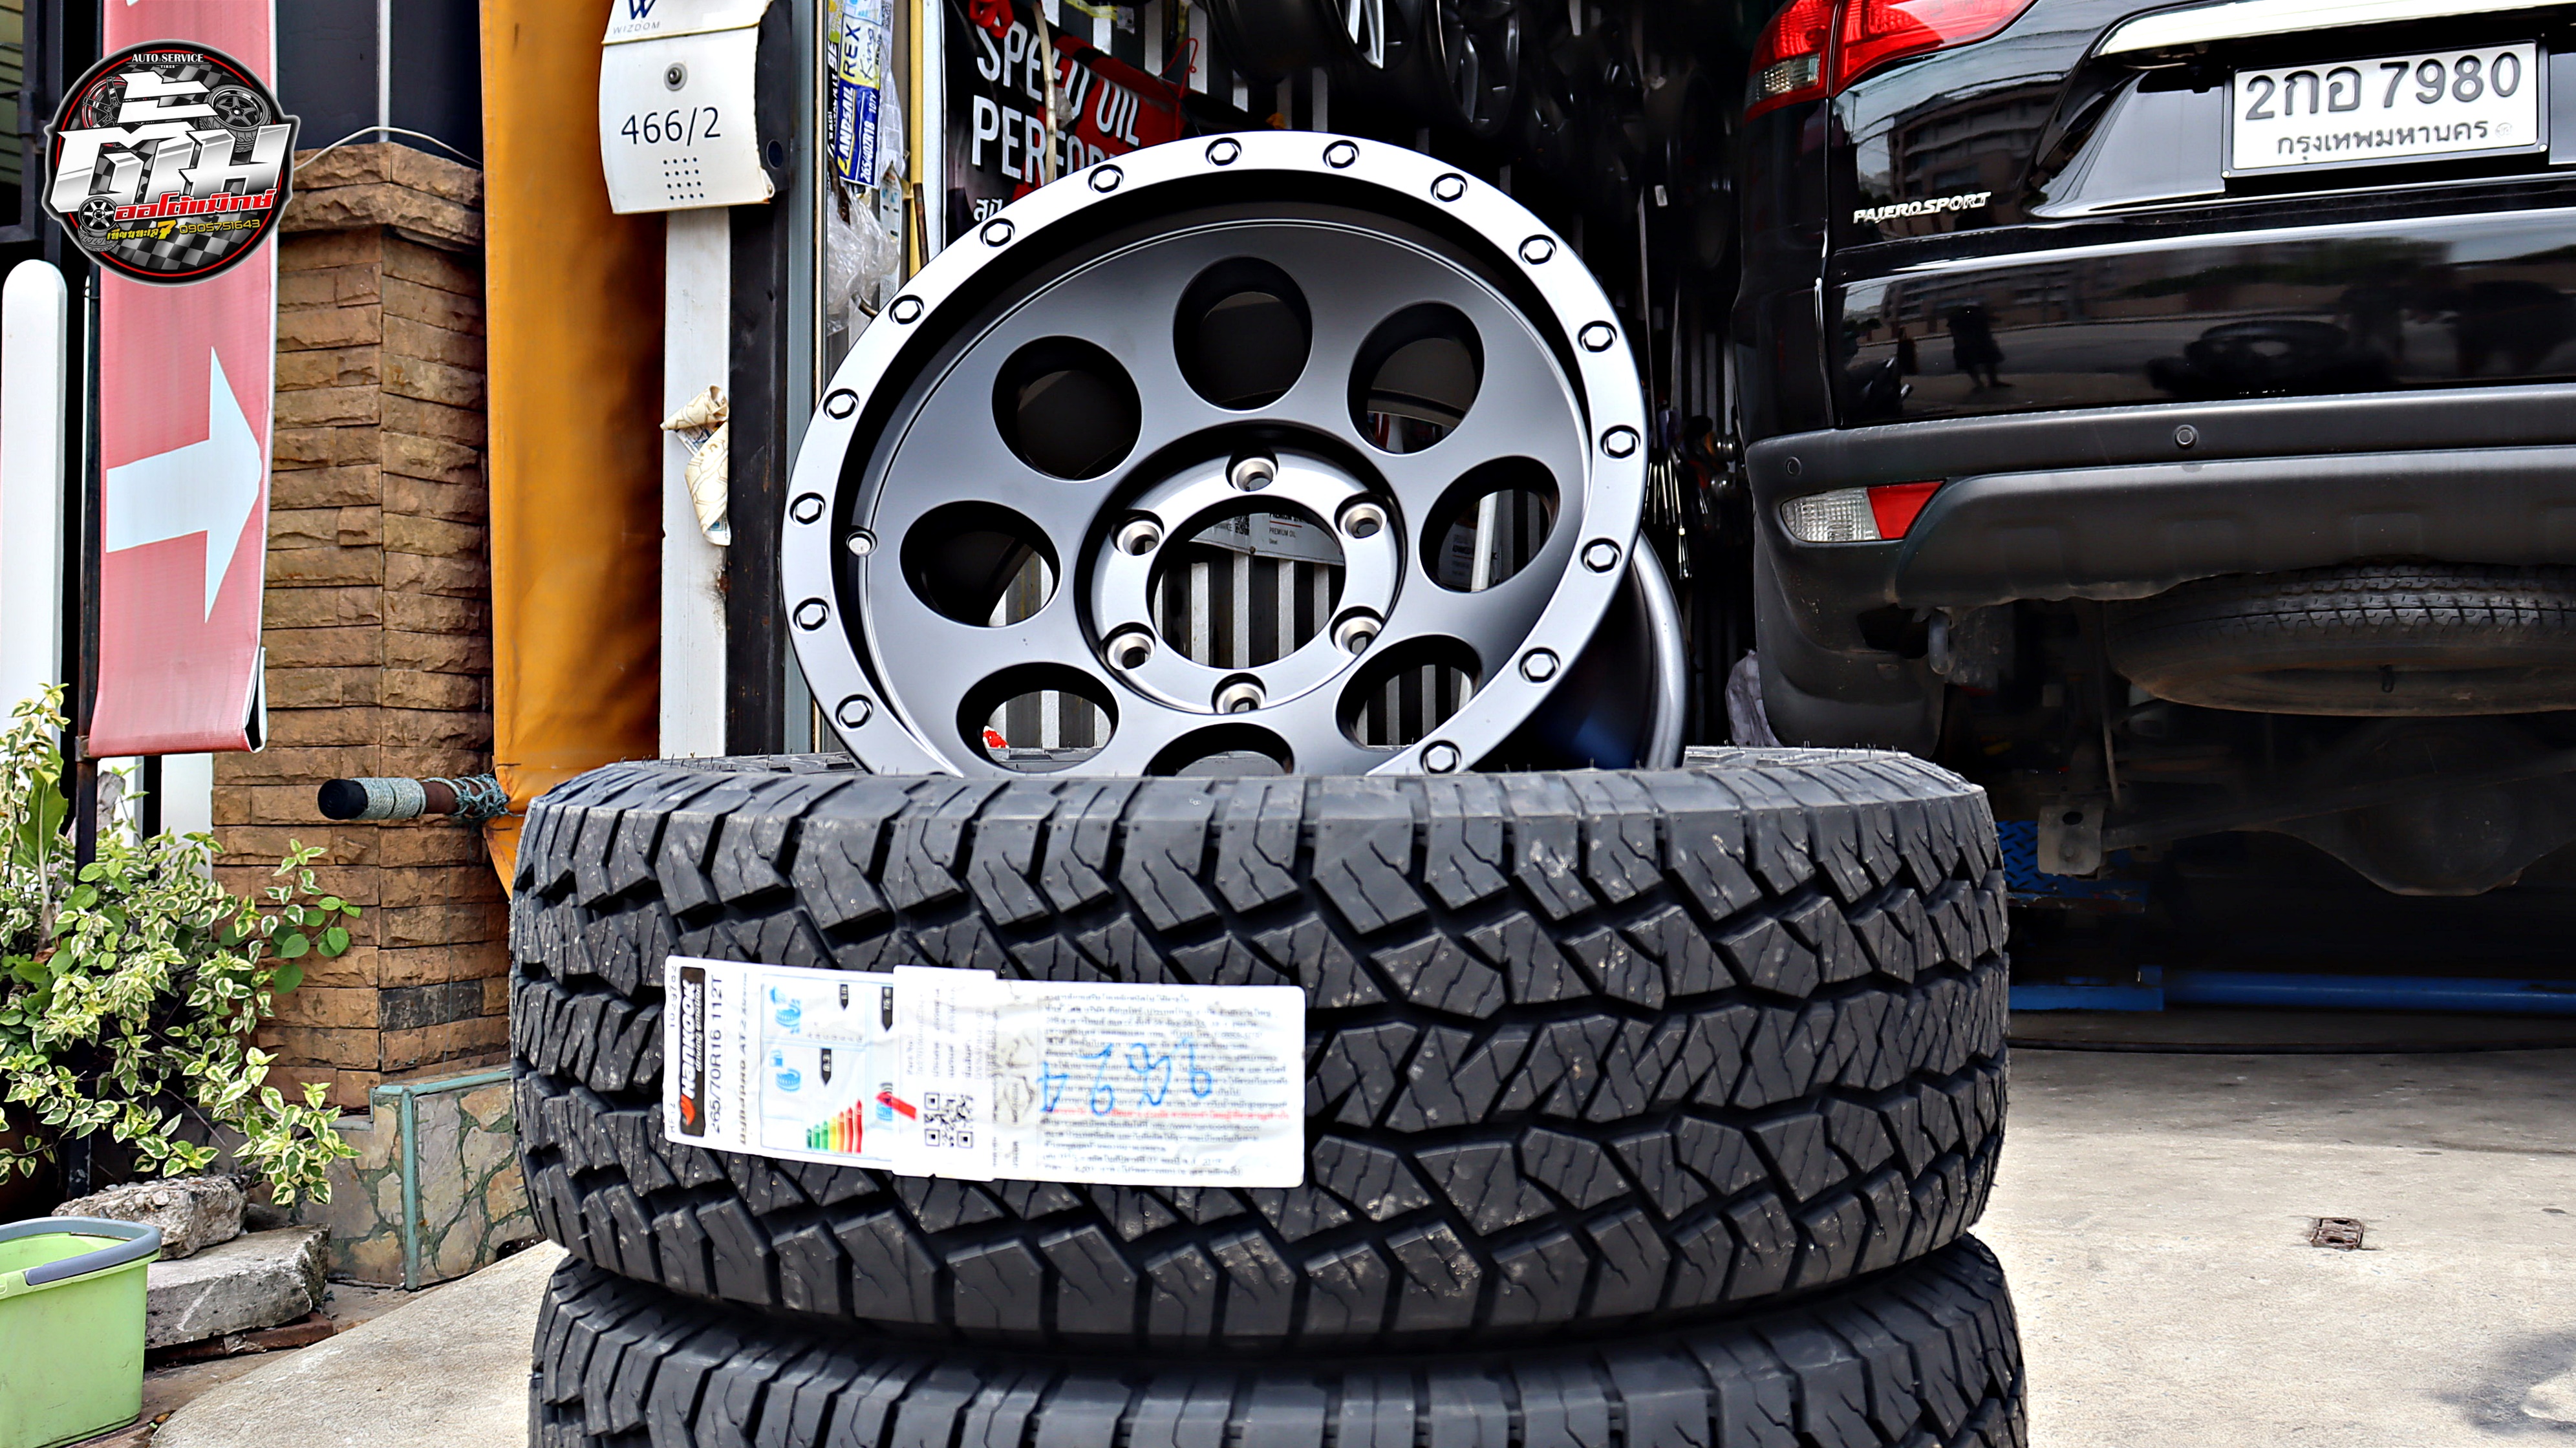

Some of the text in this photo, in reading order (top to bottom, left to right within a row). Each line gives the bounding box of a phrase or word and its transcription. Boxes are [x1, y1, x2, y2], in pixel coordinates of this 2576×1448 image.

[613, 21, 661, 35] WIZDOM
[843, 22, 861, 78] REX
[2246, 52, 2522, 121] 2กอ 7980
[621, 106, 721, 147] 466/2
[837, 85, 855, 176] LANDSAIL
[860, 120, 876, 184] 265/40ZR18
[2277, 119, 2489, 161] กรุงเทพมหานคร
[694, 1032, 703, 1072] driving
[709, 974, 723, 1134] 265/70R16 112T
